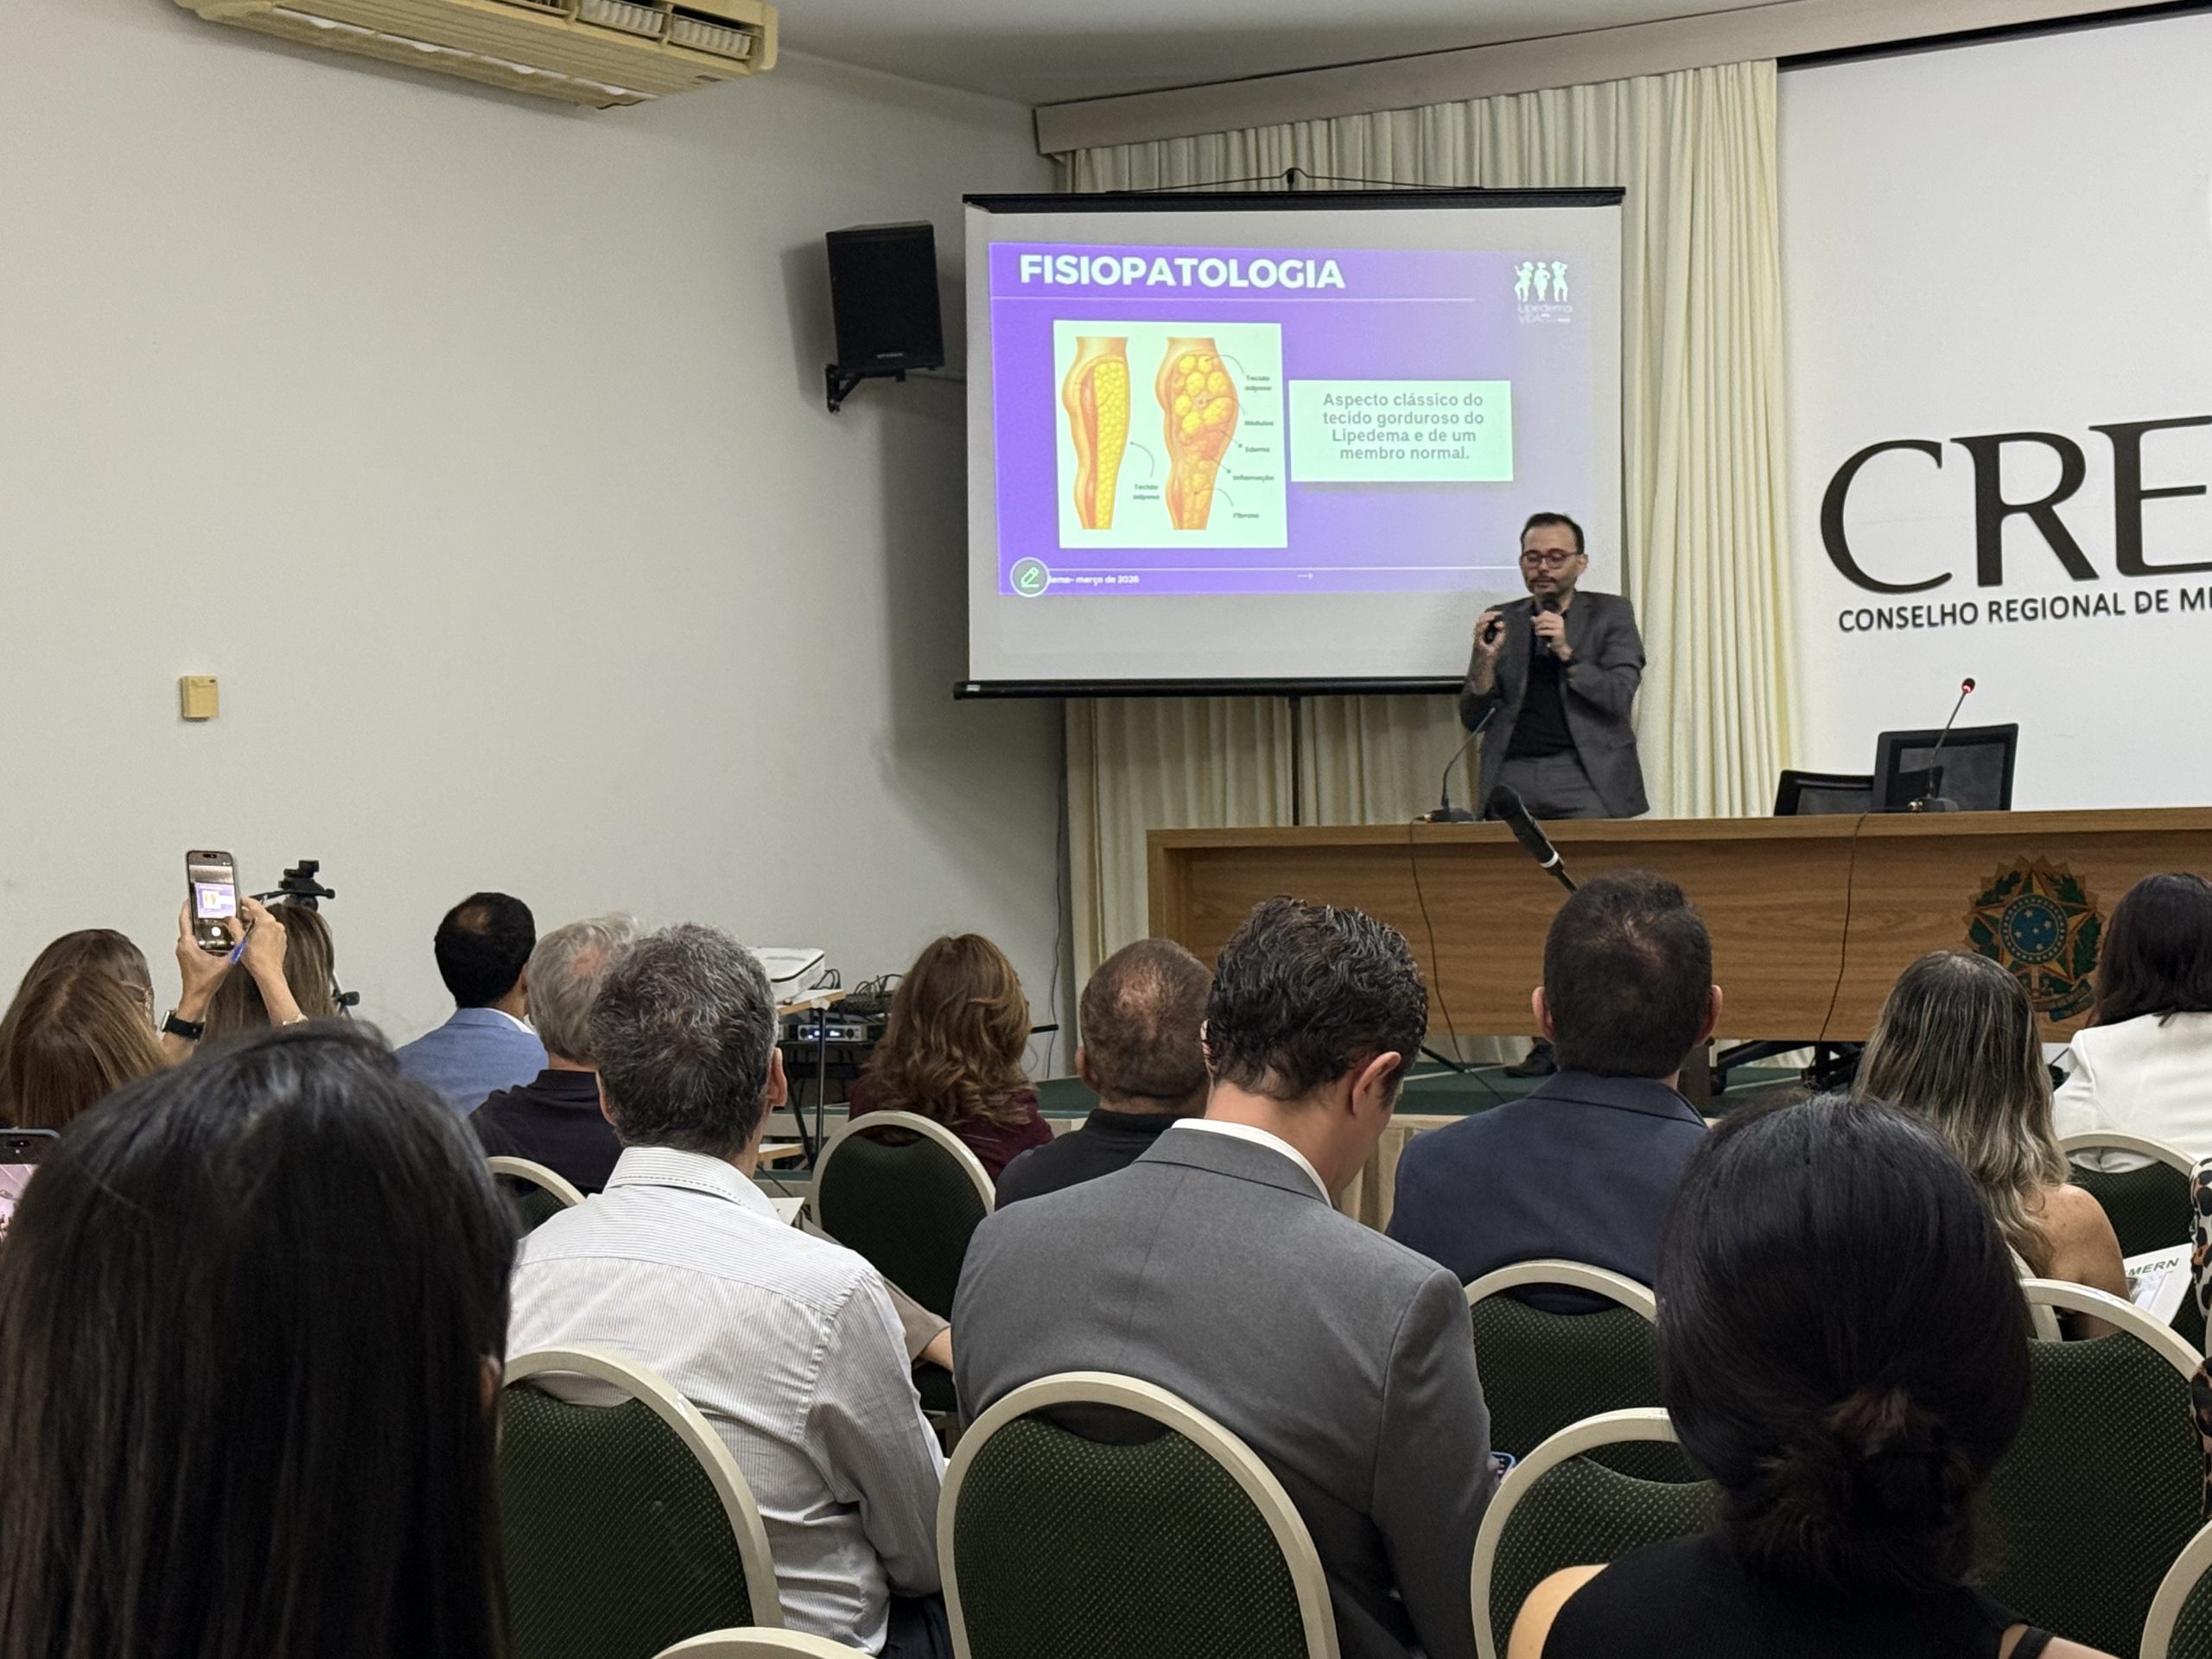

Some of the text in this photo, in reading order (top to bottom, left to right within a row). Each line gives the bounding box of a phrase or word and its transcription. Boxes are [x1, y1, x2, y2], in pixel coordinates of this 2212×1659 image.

[1020, 254, 1346, 289] FISIOPATOLOGIA
[1323, 392, 1484, 410] Aspecto clássico do
[1323, 411, 1484, 428] tecido gorduroso do
[1332, 429, 1477, 445] Lipedema e de um
[1340, 446, 1471, 460] membro normal.
[1820, 415, 2212, 596] CRE
[1076, 576, 1103, 587] março
[1105, 575, 1116, 584] de
[1838, 586, 2212, 632] CONSELHO REGIONAL DE M
[2126, 1257, 2179, 1277] MERN
